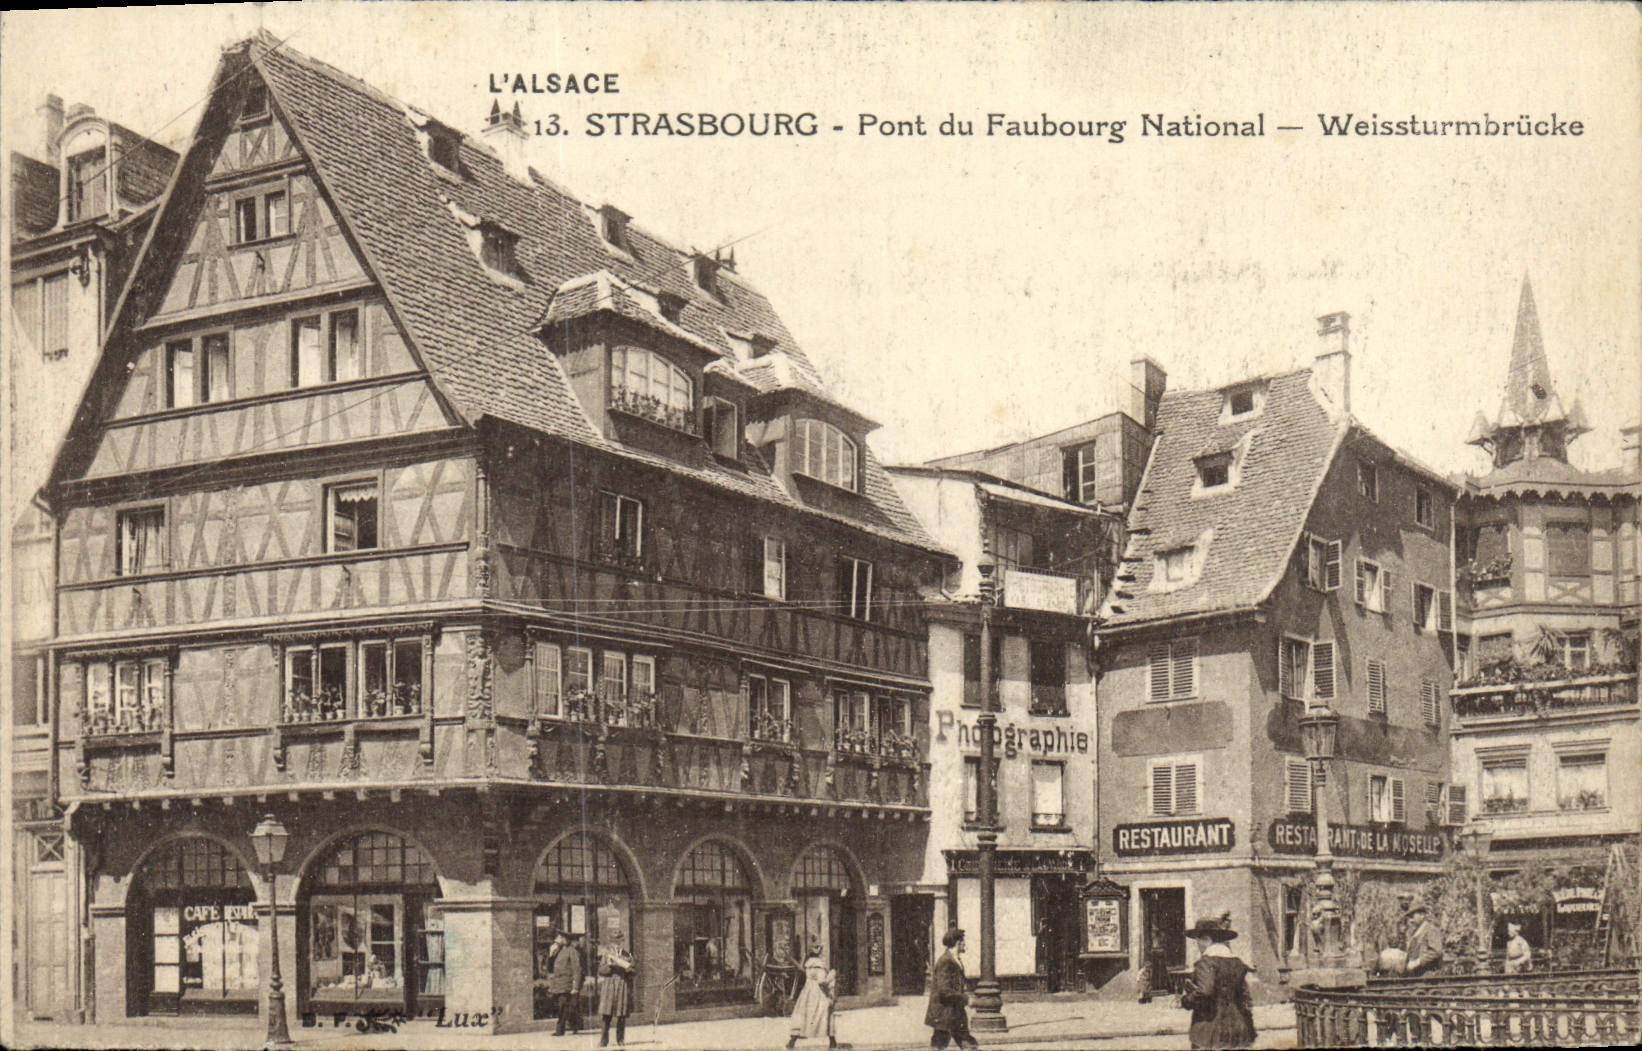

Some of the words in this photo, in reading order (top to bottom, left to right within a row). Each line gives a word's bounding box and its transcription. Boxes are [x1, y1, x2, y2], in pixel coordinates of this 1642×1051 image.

[936, 710, 1088, 759] Phoographie
[1119, 823, 1230, 849] RESTAURANT
[1275, 824, 1356, 849] RESTARANT
[1360, 829, 1373, 850] DE
[1376, 829, 1389, 851] LA
